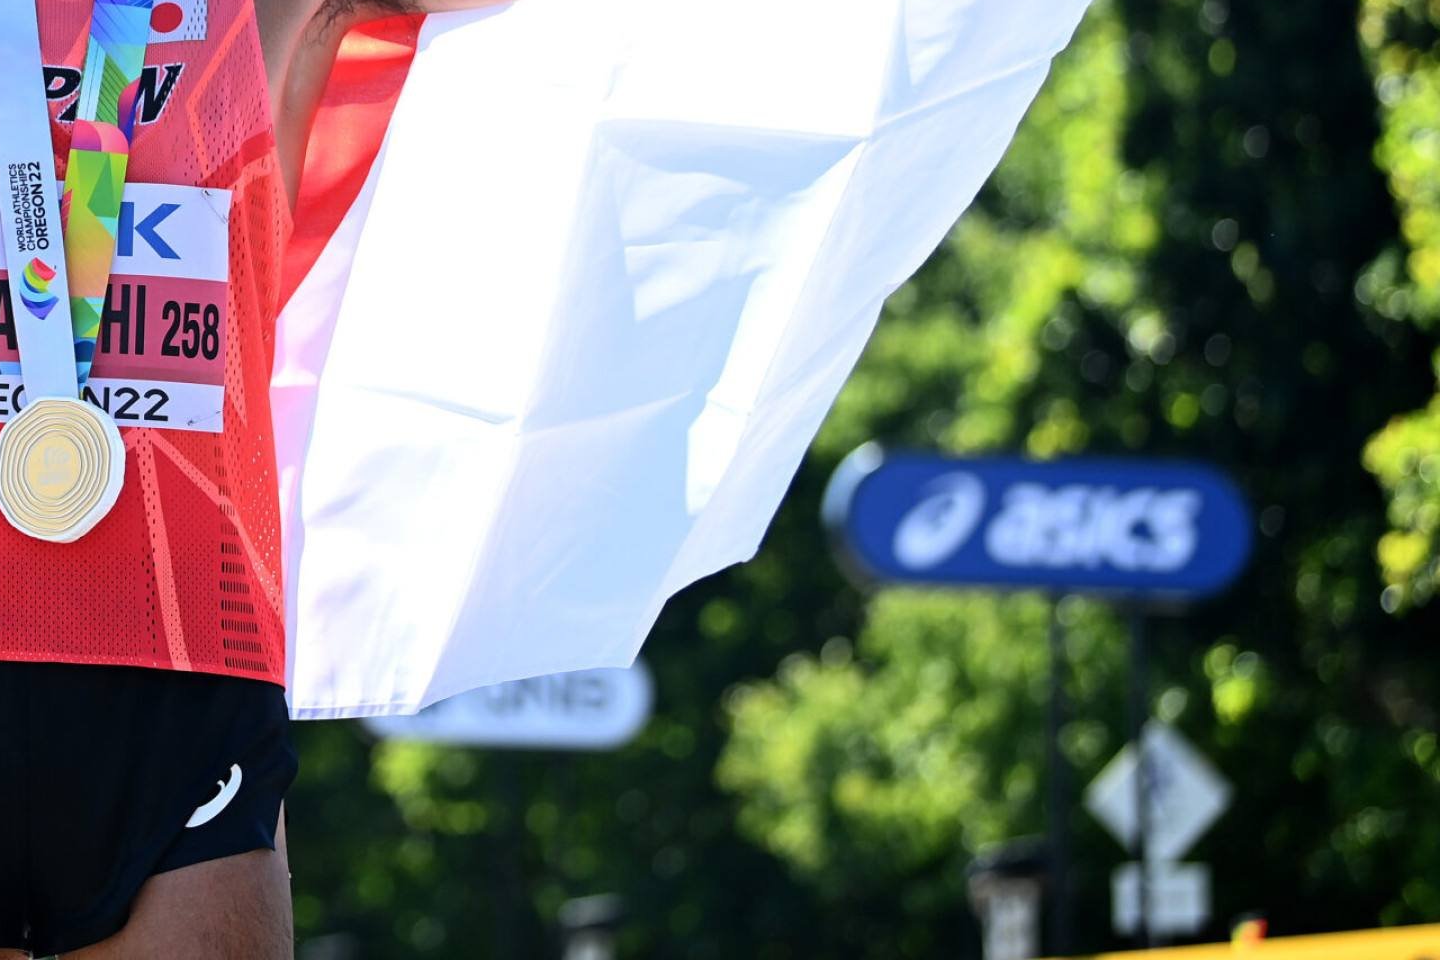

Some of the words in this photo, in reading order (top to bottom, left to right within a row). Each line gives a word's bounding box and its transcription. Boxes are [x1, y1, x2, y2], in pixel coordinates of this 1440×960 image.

[9, 163, 22, 215] ATHLETICS
[17, 162, 36, 251] CHAMPIONSHIPS
[15, 217, 26, 252] WORLD
[161, 300, 220, 360] 258
